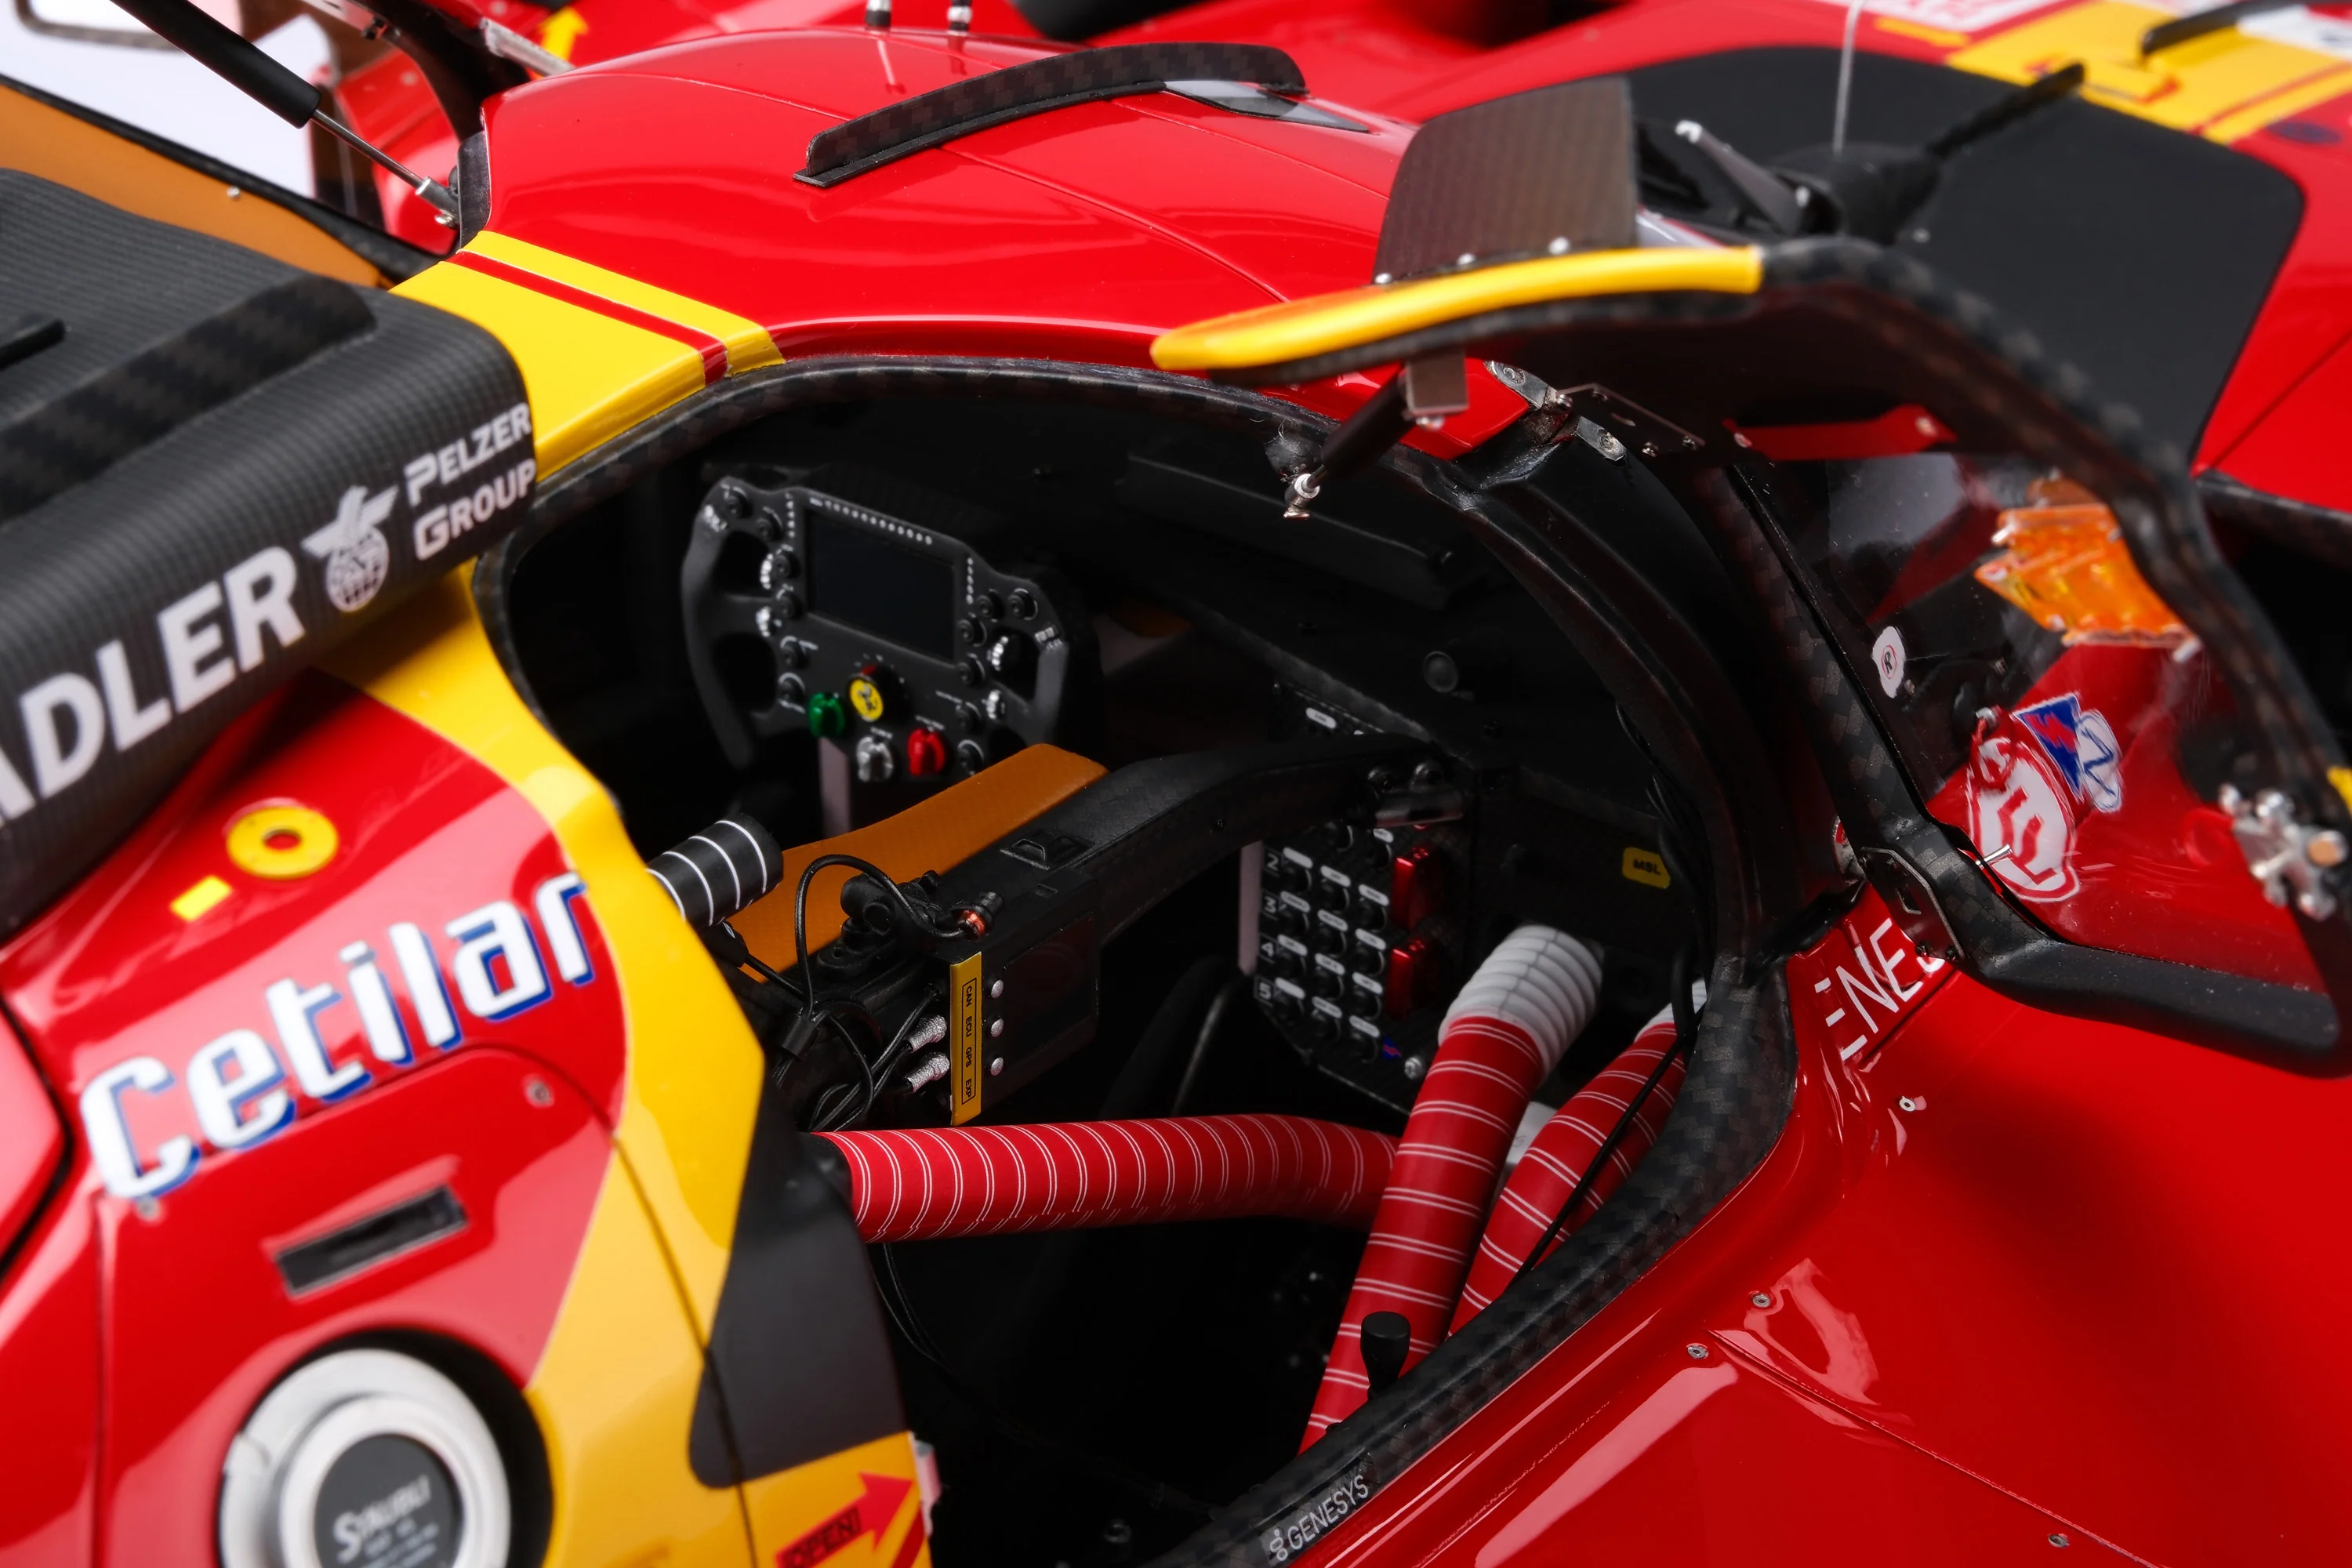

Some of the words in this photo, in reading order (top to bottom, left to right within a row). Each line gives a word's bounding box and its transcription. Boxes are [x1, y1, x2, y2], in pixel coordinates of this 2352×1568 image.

[404, 402, 532, 507] PELZER
[413, 458, 536, 561] GROUP
[1267, 853, 1279, 871] 2
[1264, 895, 1276, 913] 3
[1261, 942, 1275, 957] 4
[1258, 982, 1272, 1000] 5
[80, 871, 594, 1199] Cetilar
[1287, 1474, 1369, 1550] GENESYS
